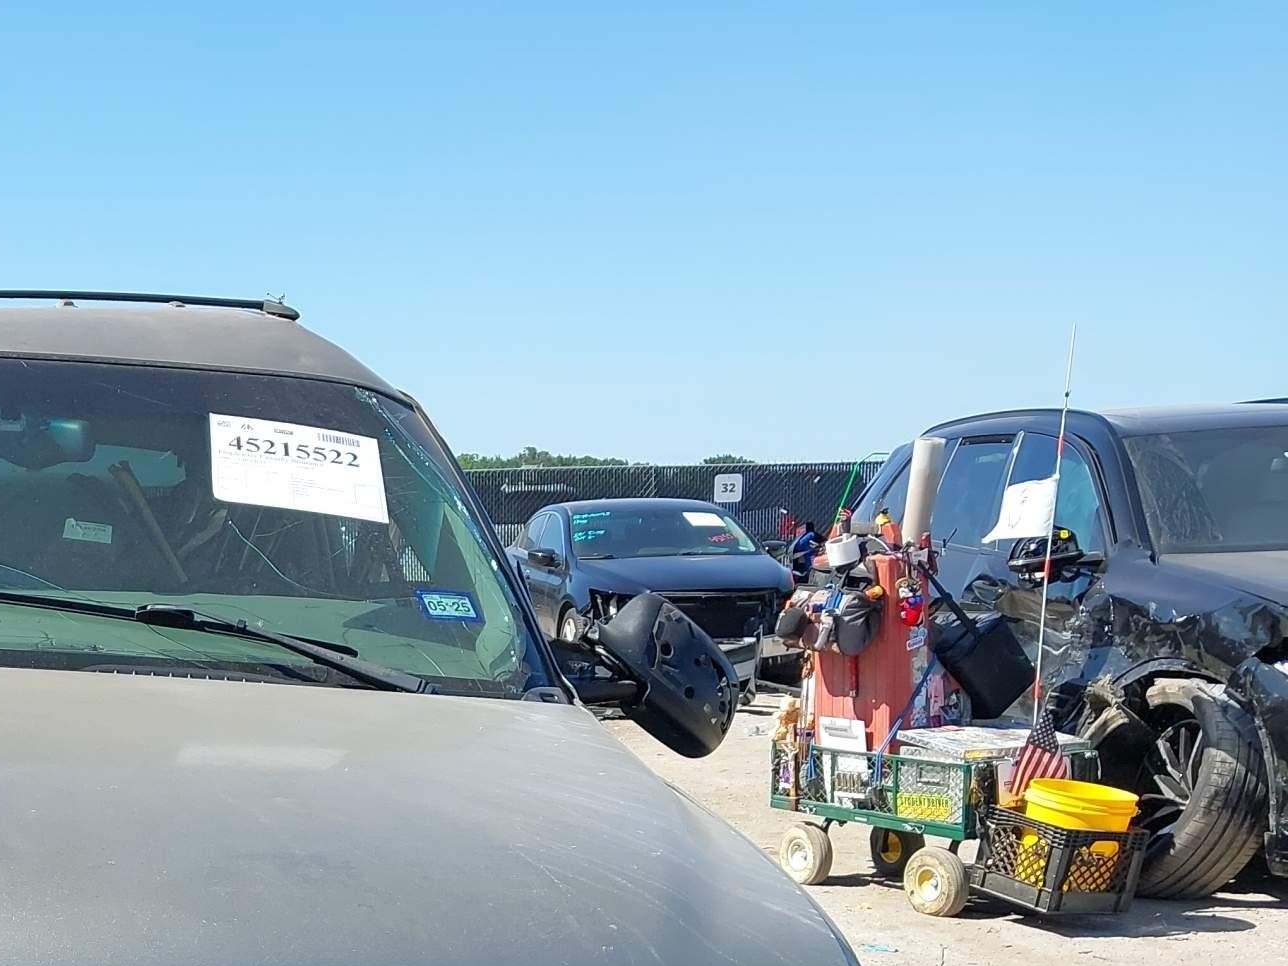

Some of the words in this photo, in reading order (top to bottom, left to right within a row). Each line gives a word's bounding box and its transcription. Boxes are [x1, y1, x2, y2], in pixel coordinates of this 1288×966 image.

[228, 436, 360, 468] 45215522
[721, 483, 736, 493] 32
[900, 796, 926, 807] STUDENT
[927, 798, 949, 809] DRIVER
